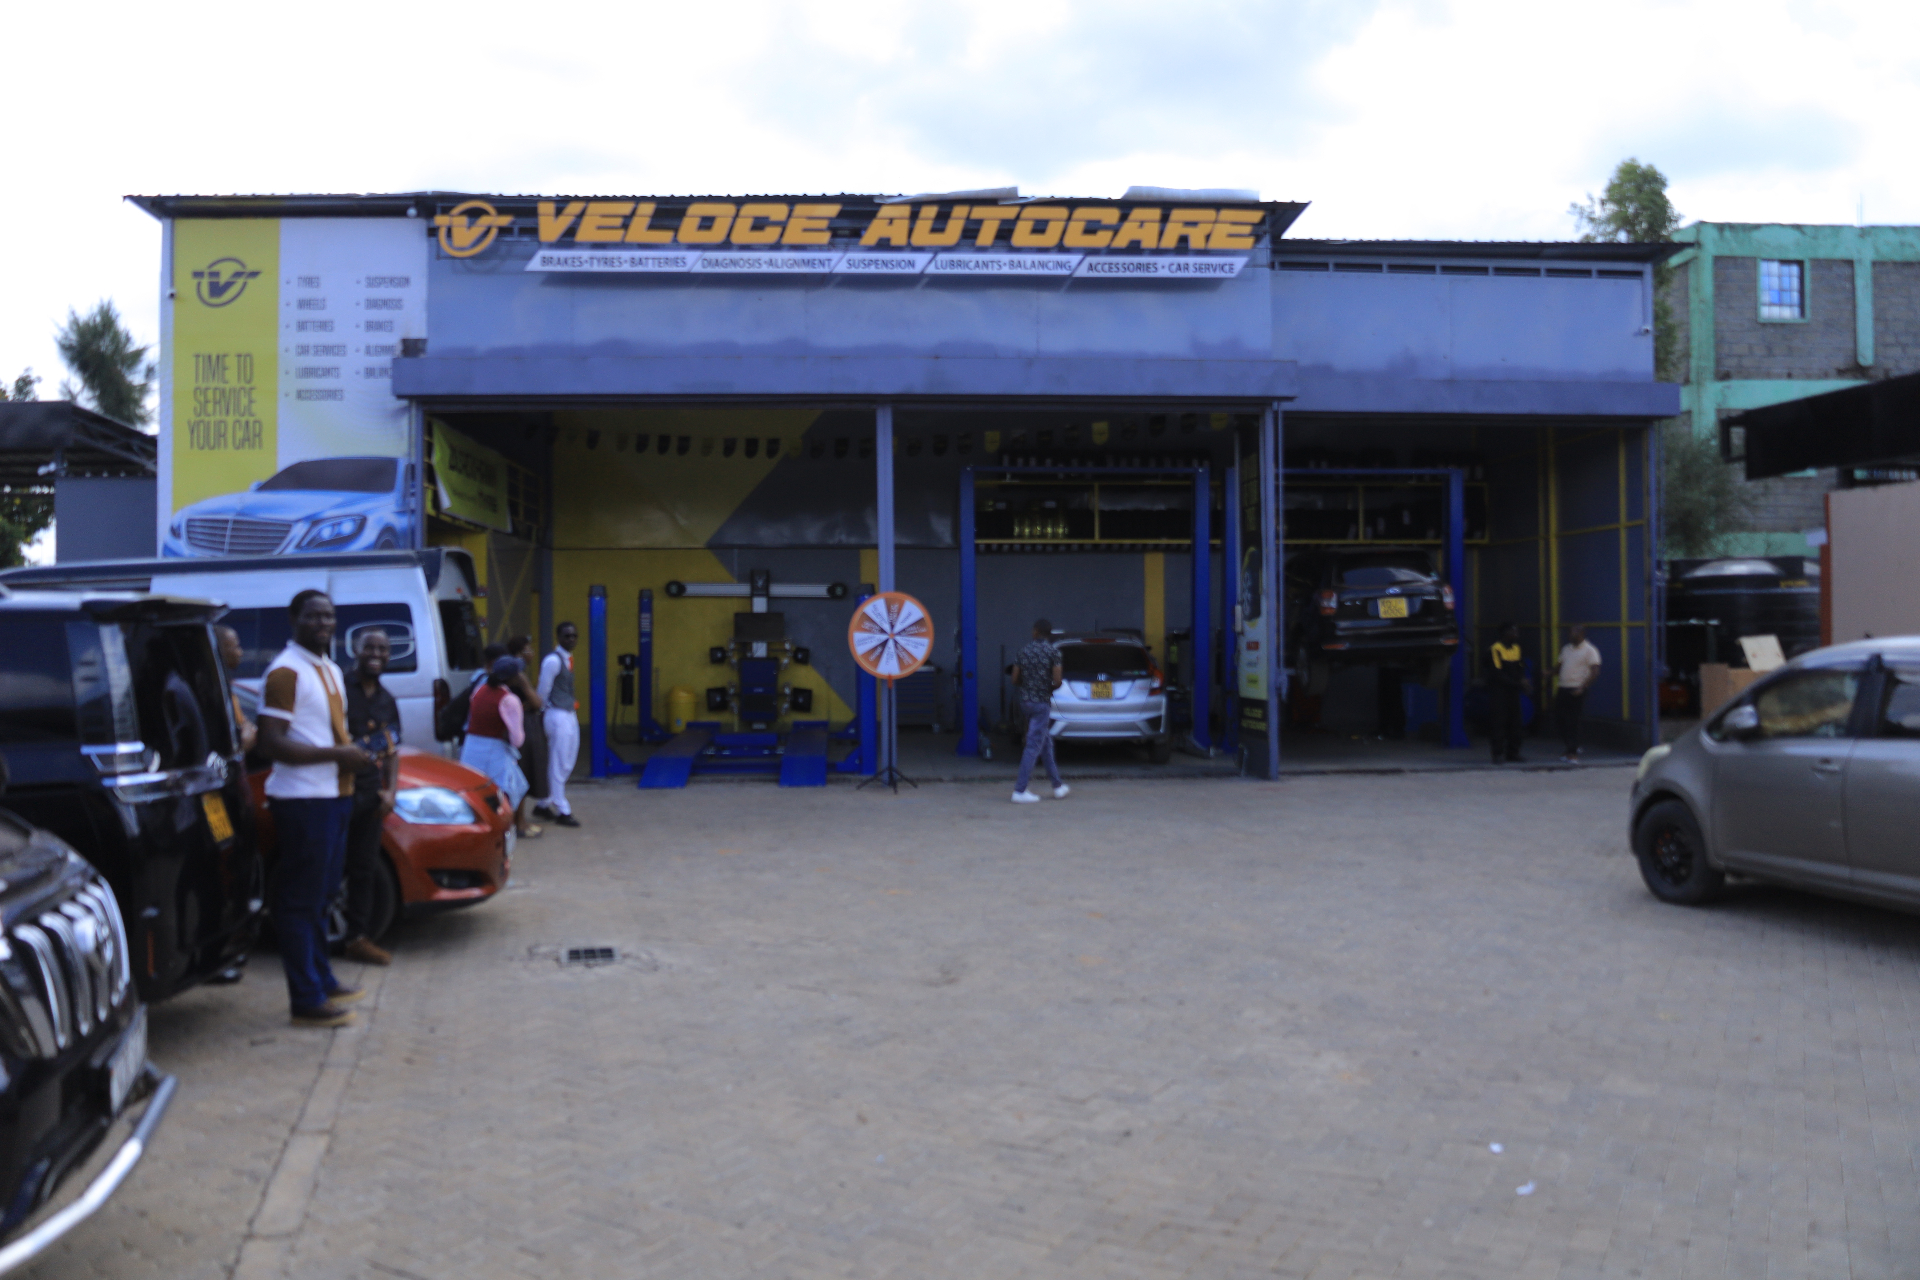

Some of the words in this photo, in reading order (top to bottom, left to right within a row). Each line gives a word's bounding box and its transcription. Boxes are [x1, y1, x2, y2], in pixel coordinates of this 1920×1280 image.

[537, 201, 843, 245] VELOCE
[858, 204, 1265, 250] AUTOCARE
[846, 258, 915, 270] SUSPENSION
[1087, 262, 1158, 273] ACCESSORIES
[1168, 263, 1190, 274] CAR
[1193, 263, 1235, 274] SERVICE
[297, 276, 320, 289] TYRES
[365, 276, 411, 289] SUSPENSION
[296, 298, 327, 311] WHEELS
[364, 298, 403, 311] DIAGNOSIS
[296, 320, 335, 333] BATTERIES
[364, 320, 394, 333] BRAKES
[295, 344, 310, 357] CAR
[313, 344, 347, 357] SERVICES
[193, 354, 229, 384] TIME
[235, 354, 254, 384] TO
[295, 366, 340, 379] LUBRICANTS
[296, 388, 344, 401] ACCESSORIES
[193, 387, 256, 417] SERVICE
[188, 419, 228, 450] YOUR
[232, 419, 263, 450] CAR
